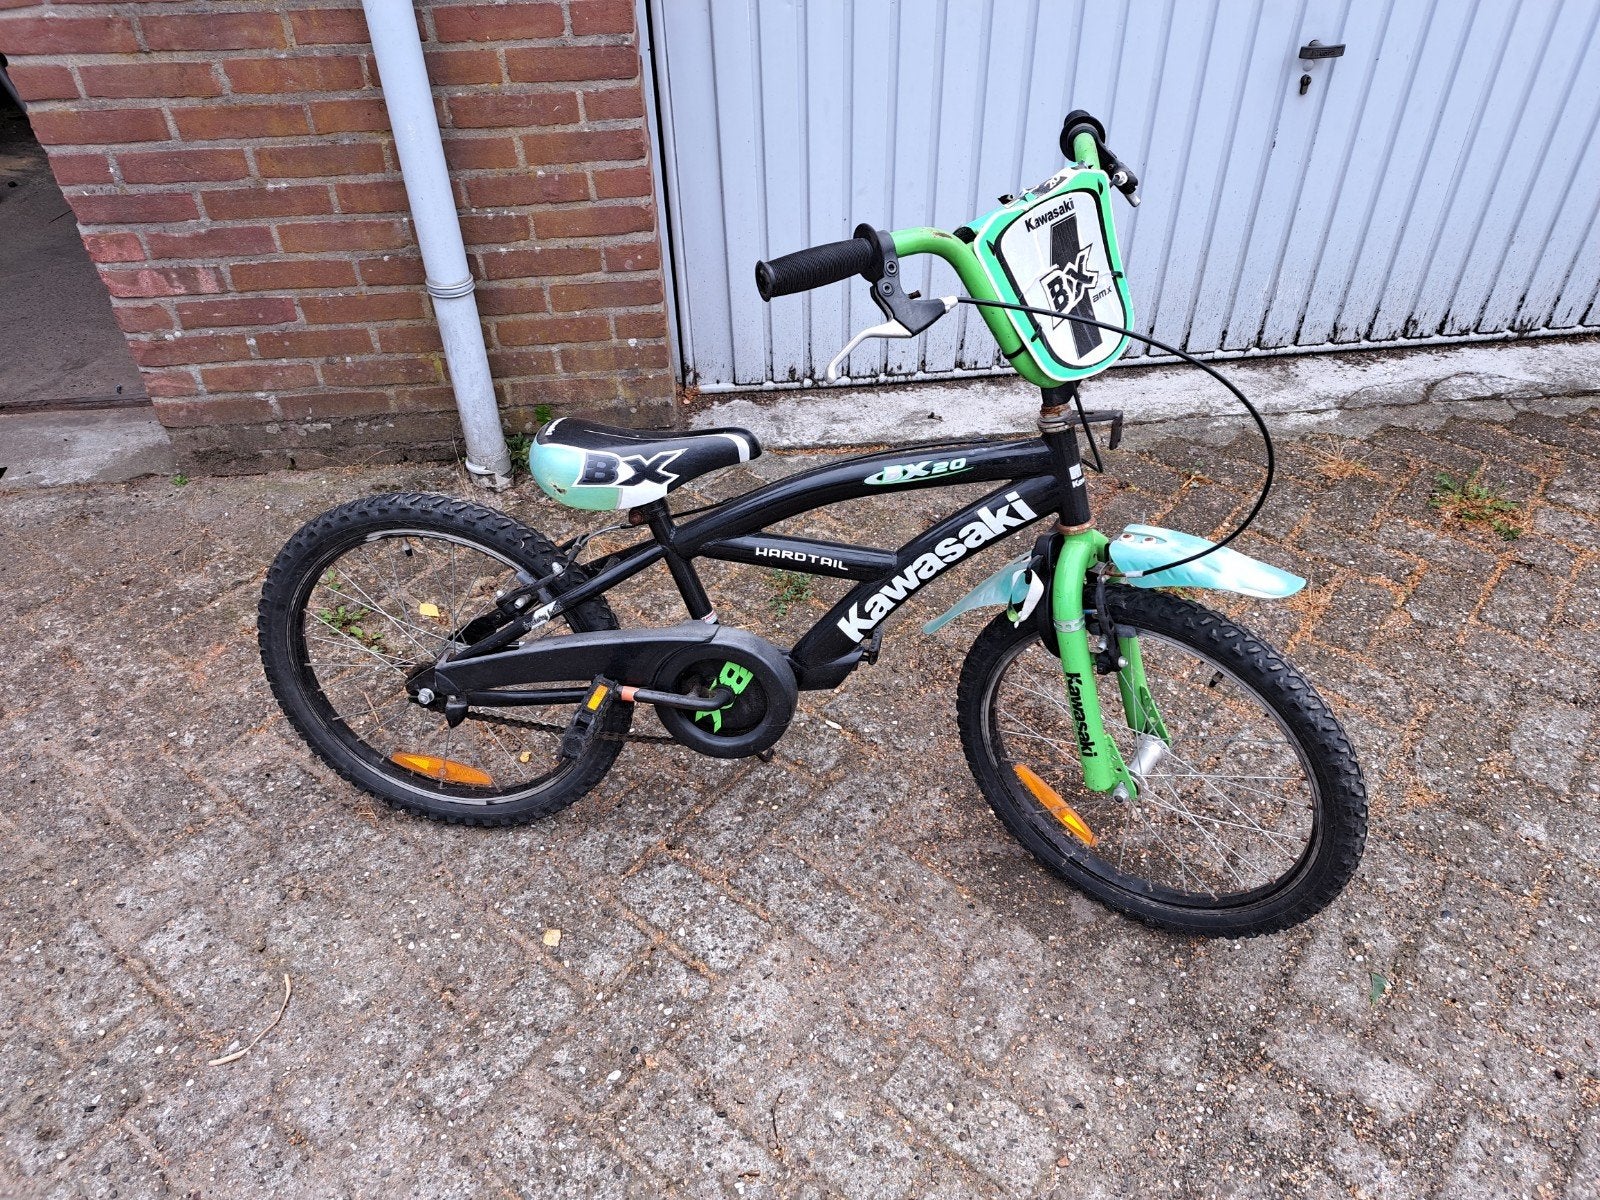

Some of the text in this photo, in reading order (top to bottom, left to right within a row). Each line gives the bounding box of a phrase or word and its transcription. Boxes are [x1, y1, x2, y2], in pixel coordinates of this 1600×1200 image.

[1024, 198, 1075, 232] Kawasaki
[1043, 250, 1096, 313] BX
[576, 450, 684, 487] BX
[755, 547, 849, 571] HARDTAIL
[837, 491, 1038, 644] Kawasaki
[1065, 672, 1098, 757] Kawasaki
